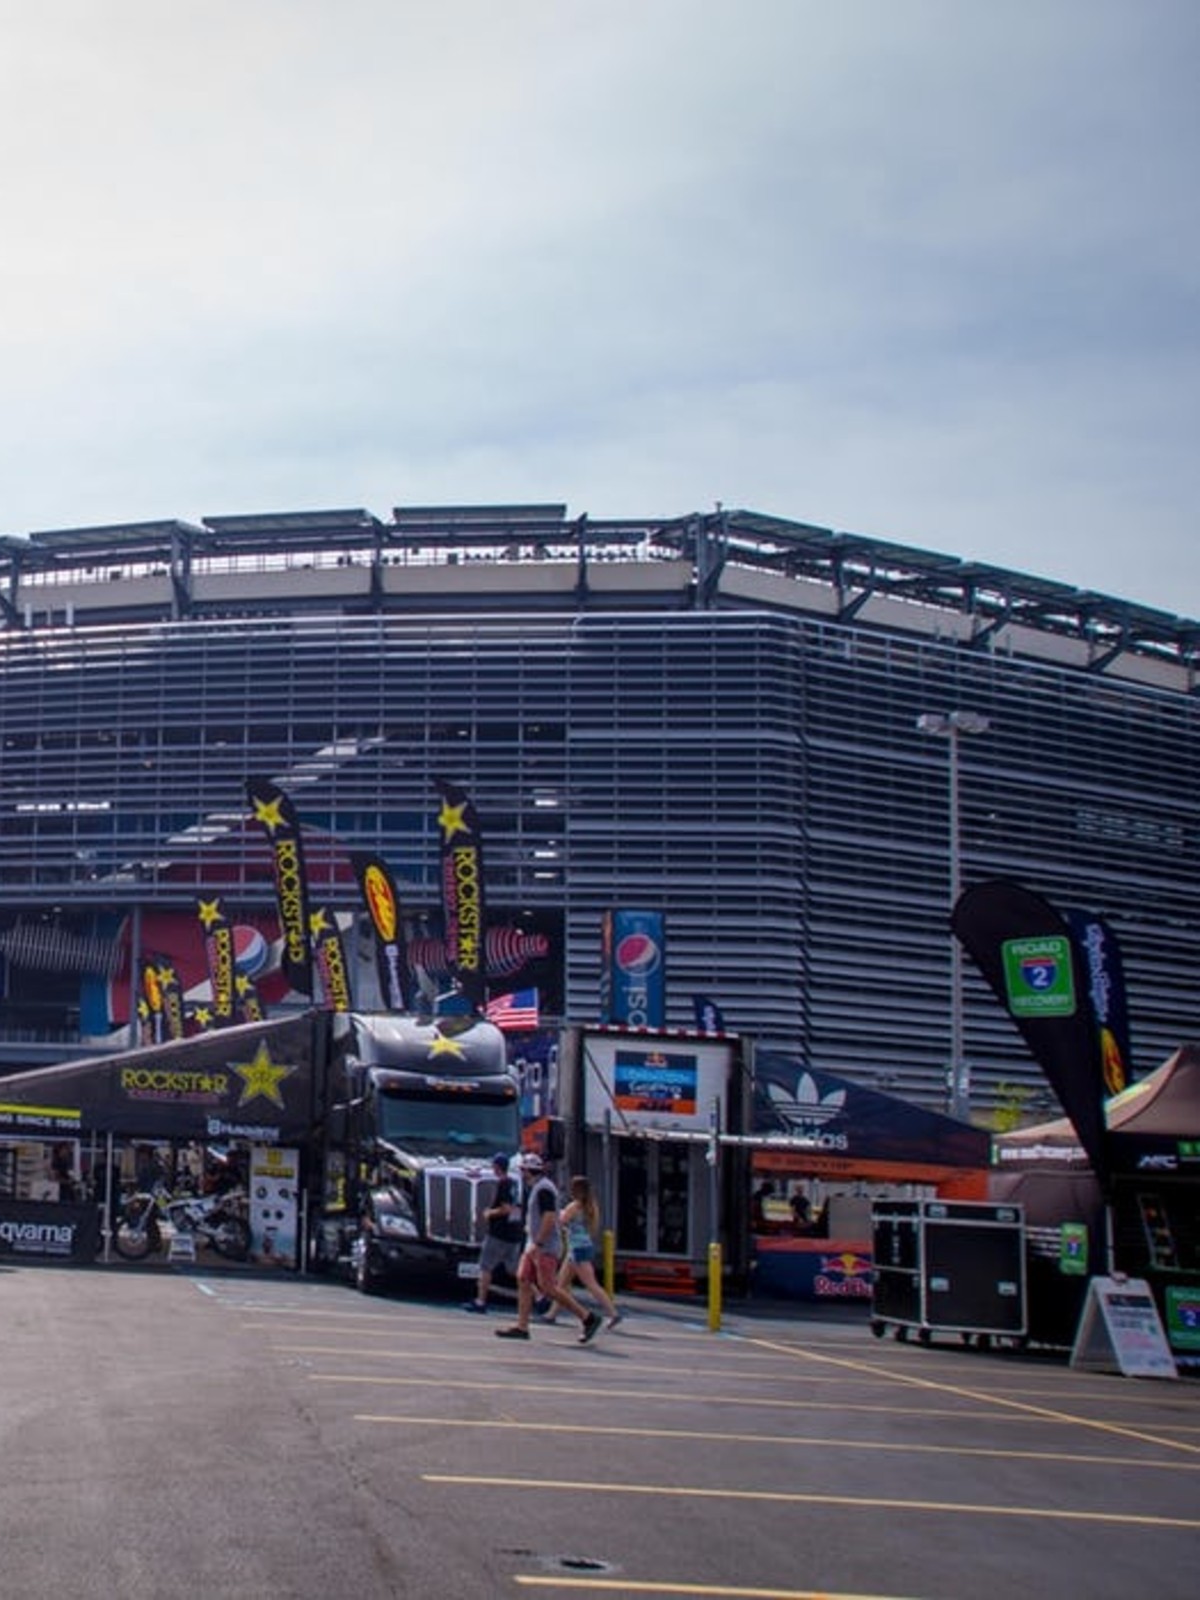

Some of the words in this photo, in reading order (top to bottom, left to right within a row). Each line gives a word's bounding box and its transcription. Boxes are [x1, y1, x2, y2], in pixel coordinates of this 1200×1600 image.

[1011, 940, 1062, 956] ROAD
[1032, 966, 1050, 987] 2
[121, 1068, 229, 1095] ROCKSTAR
[814, 1275, 849, 1295] Red
[850, 1277, 873, 1297] Bu
